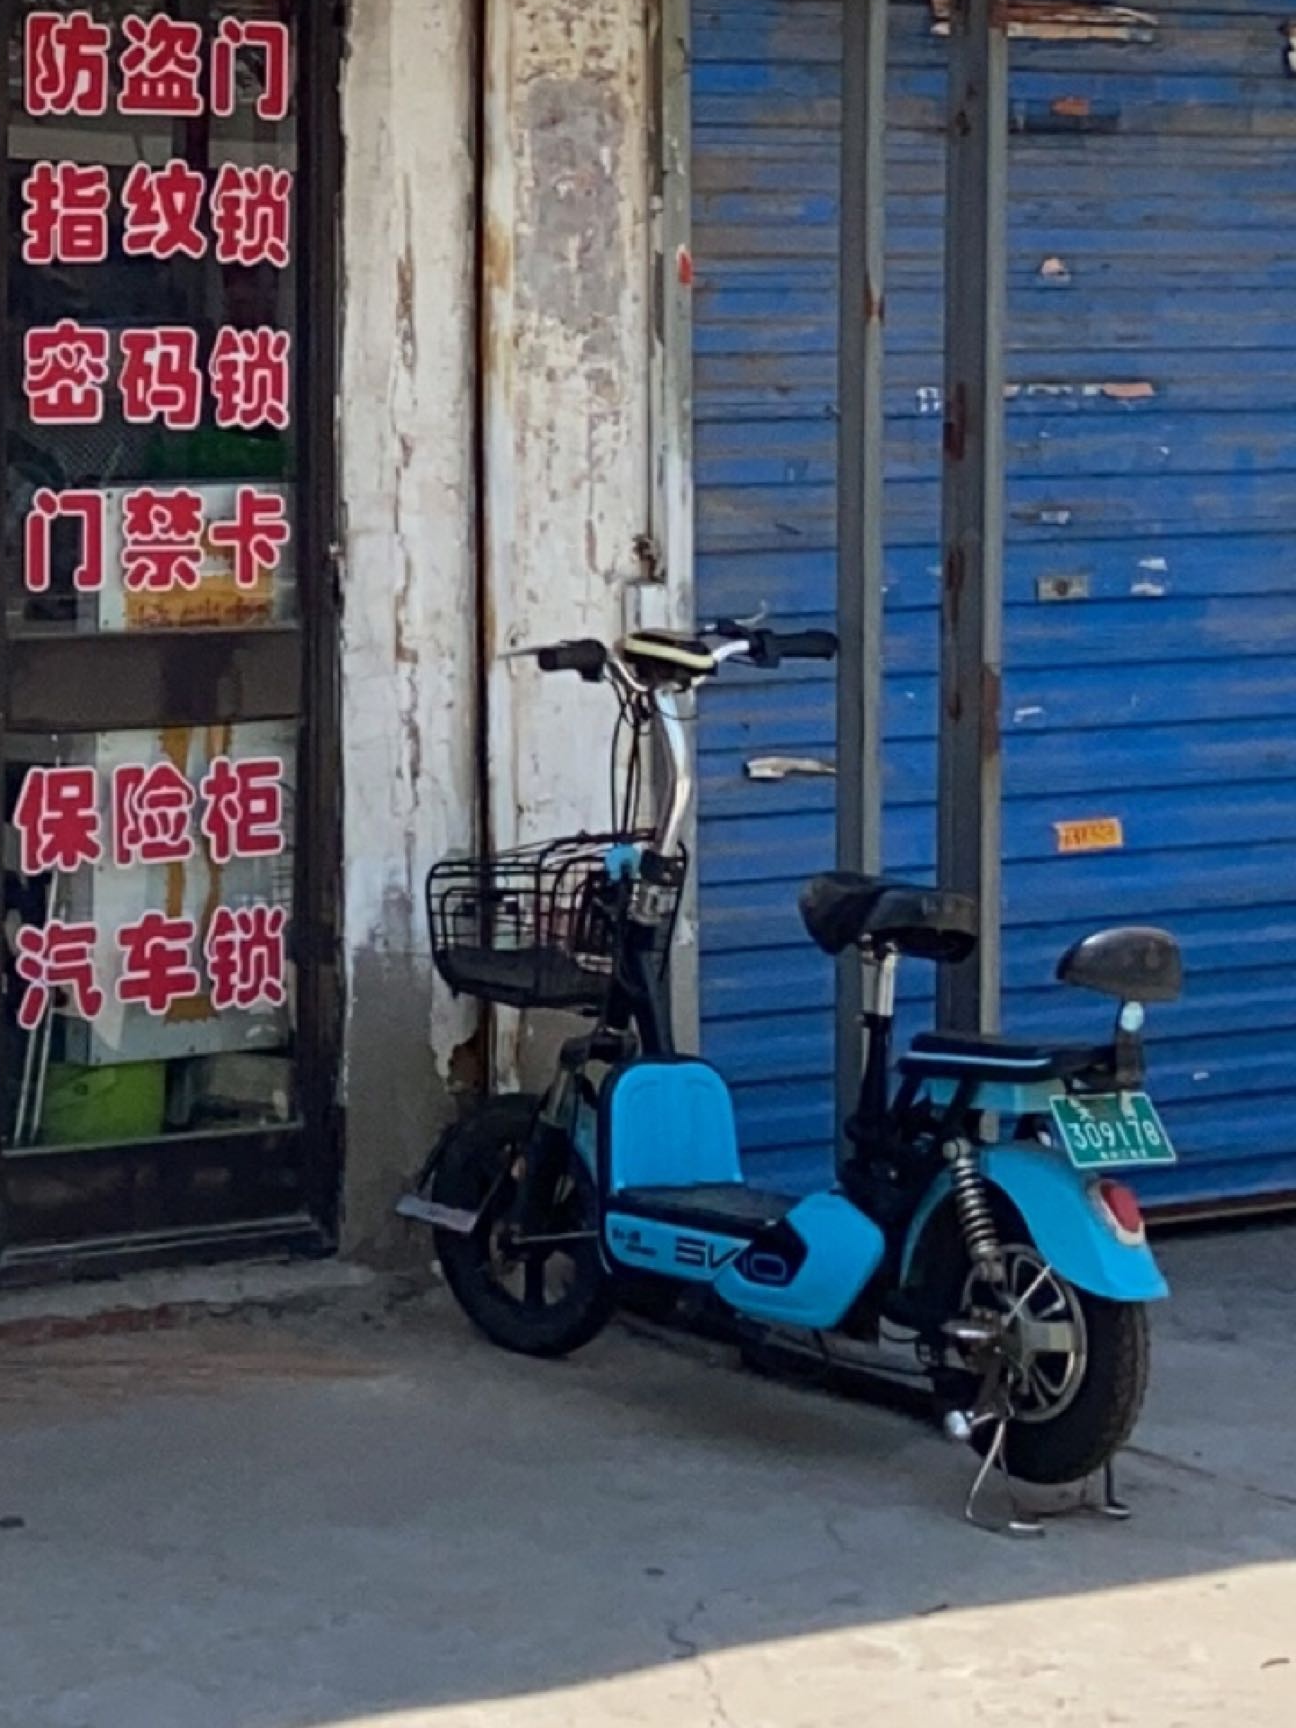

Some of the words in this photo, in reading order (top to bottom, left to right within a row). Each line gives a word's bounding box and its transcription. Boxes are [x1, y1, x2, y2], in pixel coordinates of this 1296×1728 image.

[24, 13, 290, 119] 防盗门
[23, 160, 292, 268] 指纹锁
[23, 320, 290, 431] 密码锁
[23, 487, 290, 592] 门禁卡
[14, 757, 284, 876] 保险柜
[15, 906, 287, 1030] 汽车锁
[1068, 1120, 1161, 1150] 309178
